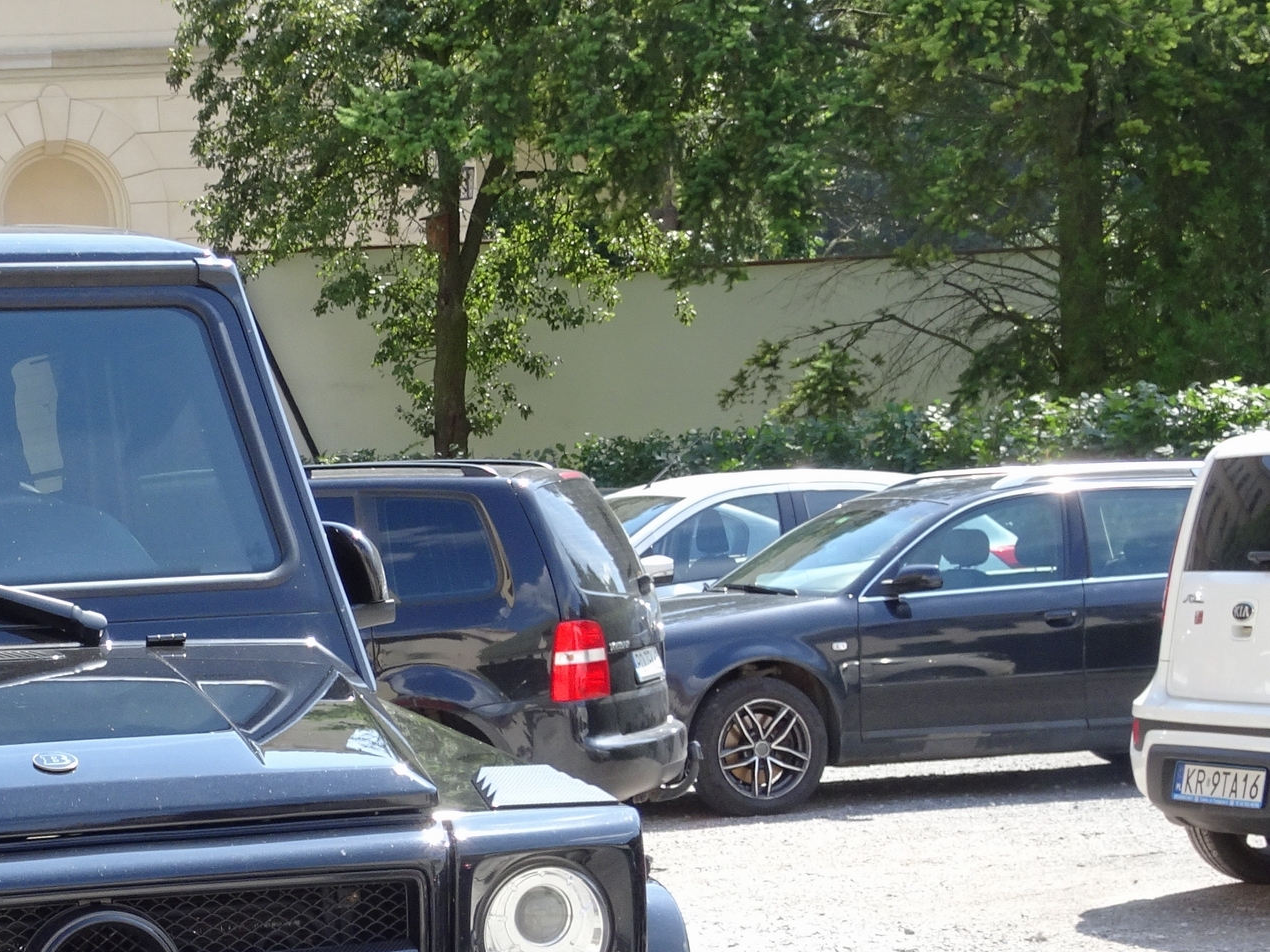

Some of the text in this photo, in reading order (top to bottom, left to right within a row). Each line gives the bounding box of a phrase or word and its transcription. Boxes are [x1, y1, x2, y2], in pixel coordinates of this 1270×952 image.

[1233, 605, 1250, 618] KIA
[1184, 768, 1260, 799] KR 9TA16
